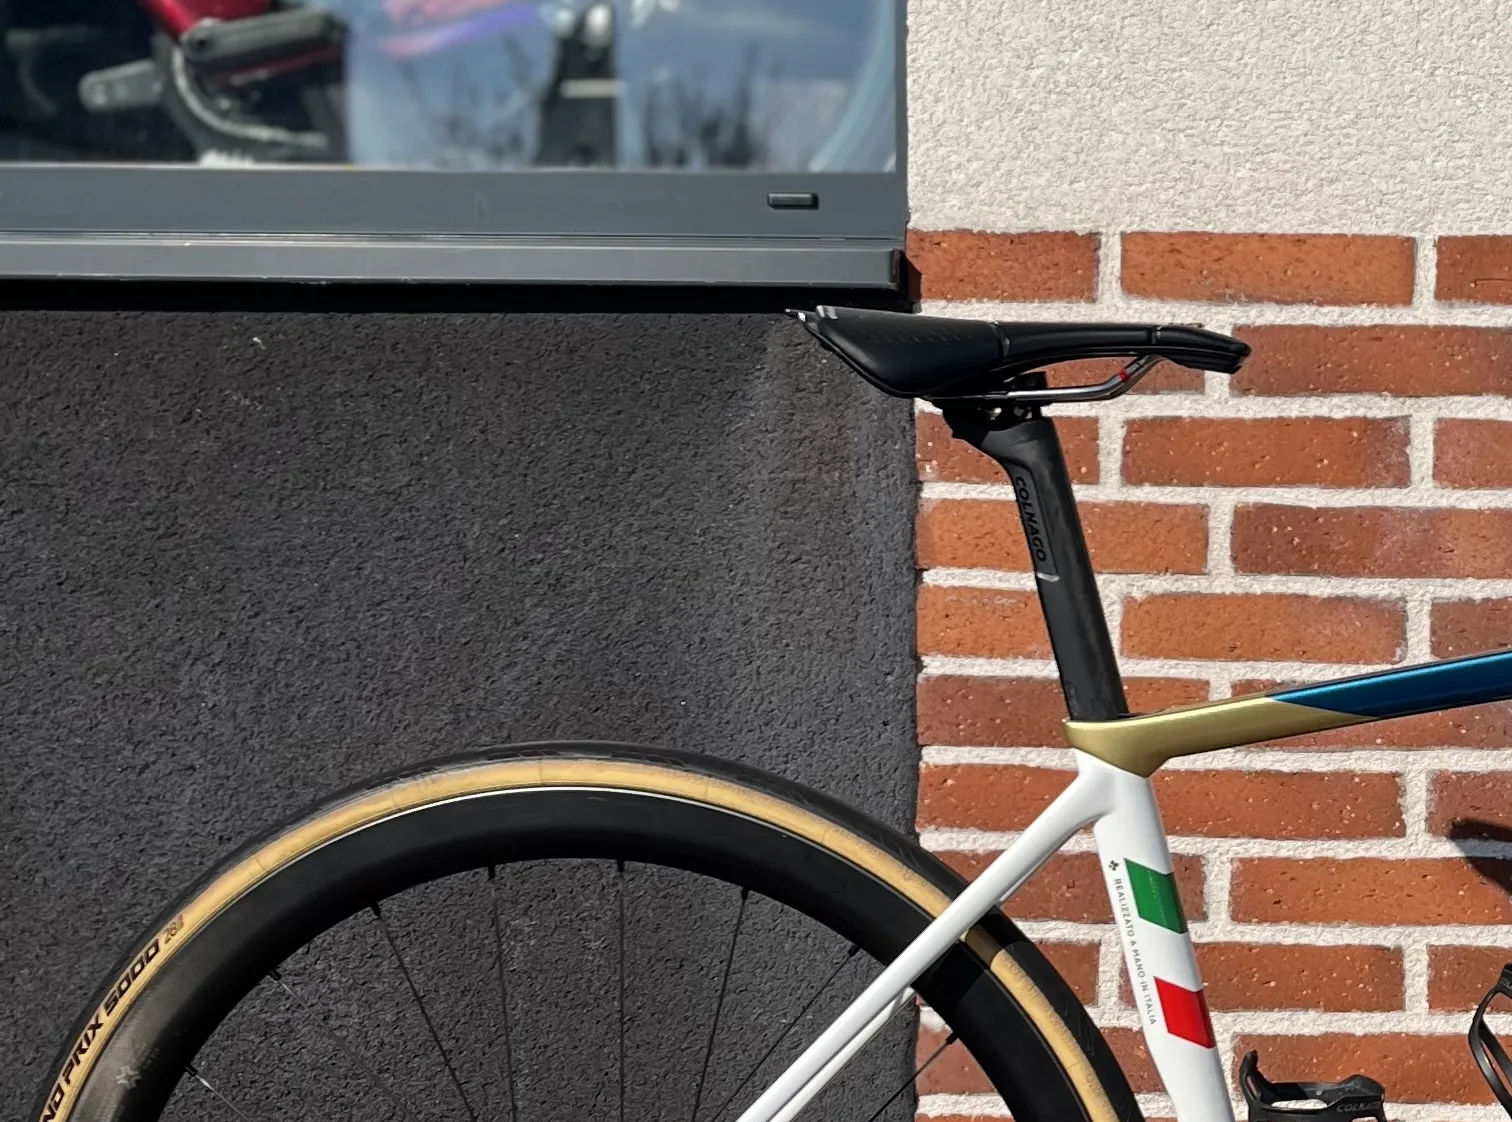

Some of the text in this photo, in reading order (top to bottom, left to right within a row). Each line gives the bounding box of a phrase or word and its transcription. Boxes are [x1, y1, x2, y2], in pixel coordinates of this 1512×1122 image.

[1015, 476, 1047, 562] COLNAGO
[1114, 878, 1136, 938] REALIZZATO
[1132, 949, 1146, 978] MANO
[1140, 981, 1149, 992] IN
[61, 1010, 104, 1086] PRIX
[103, 937, 161, 1018] 5000
[1144, 994, 1158, 1025] ITALIA
